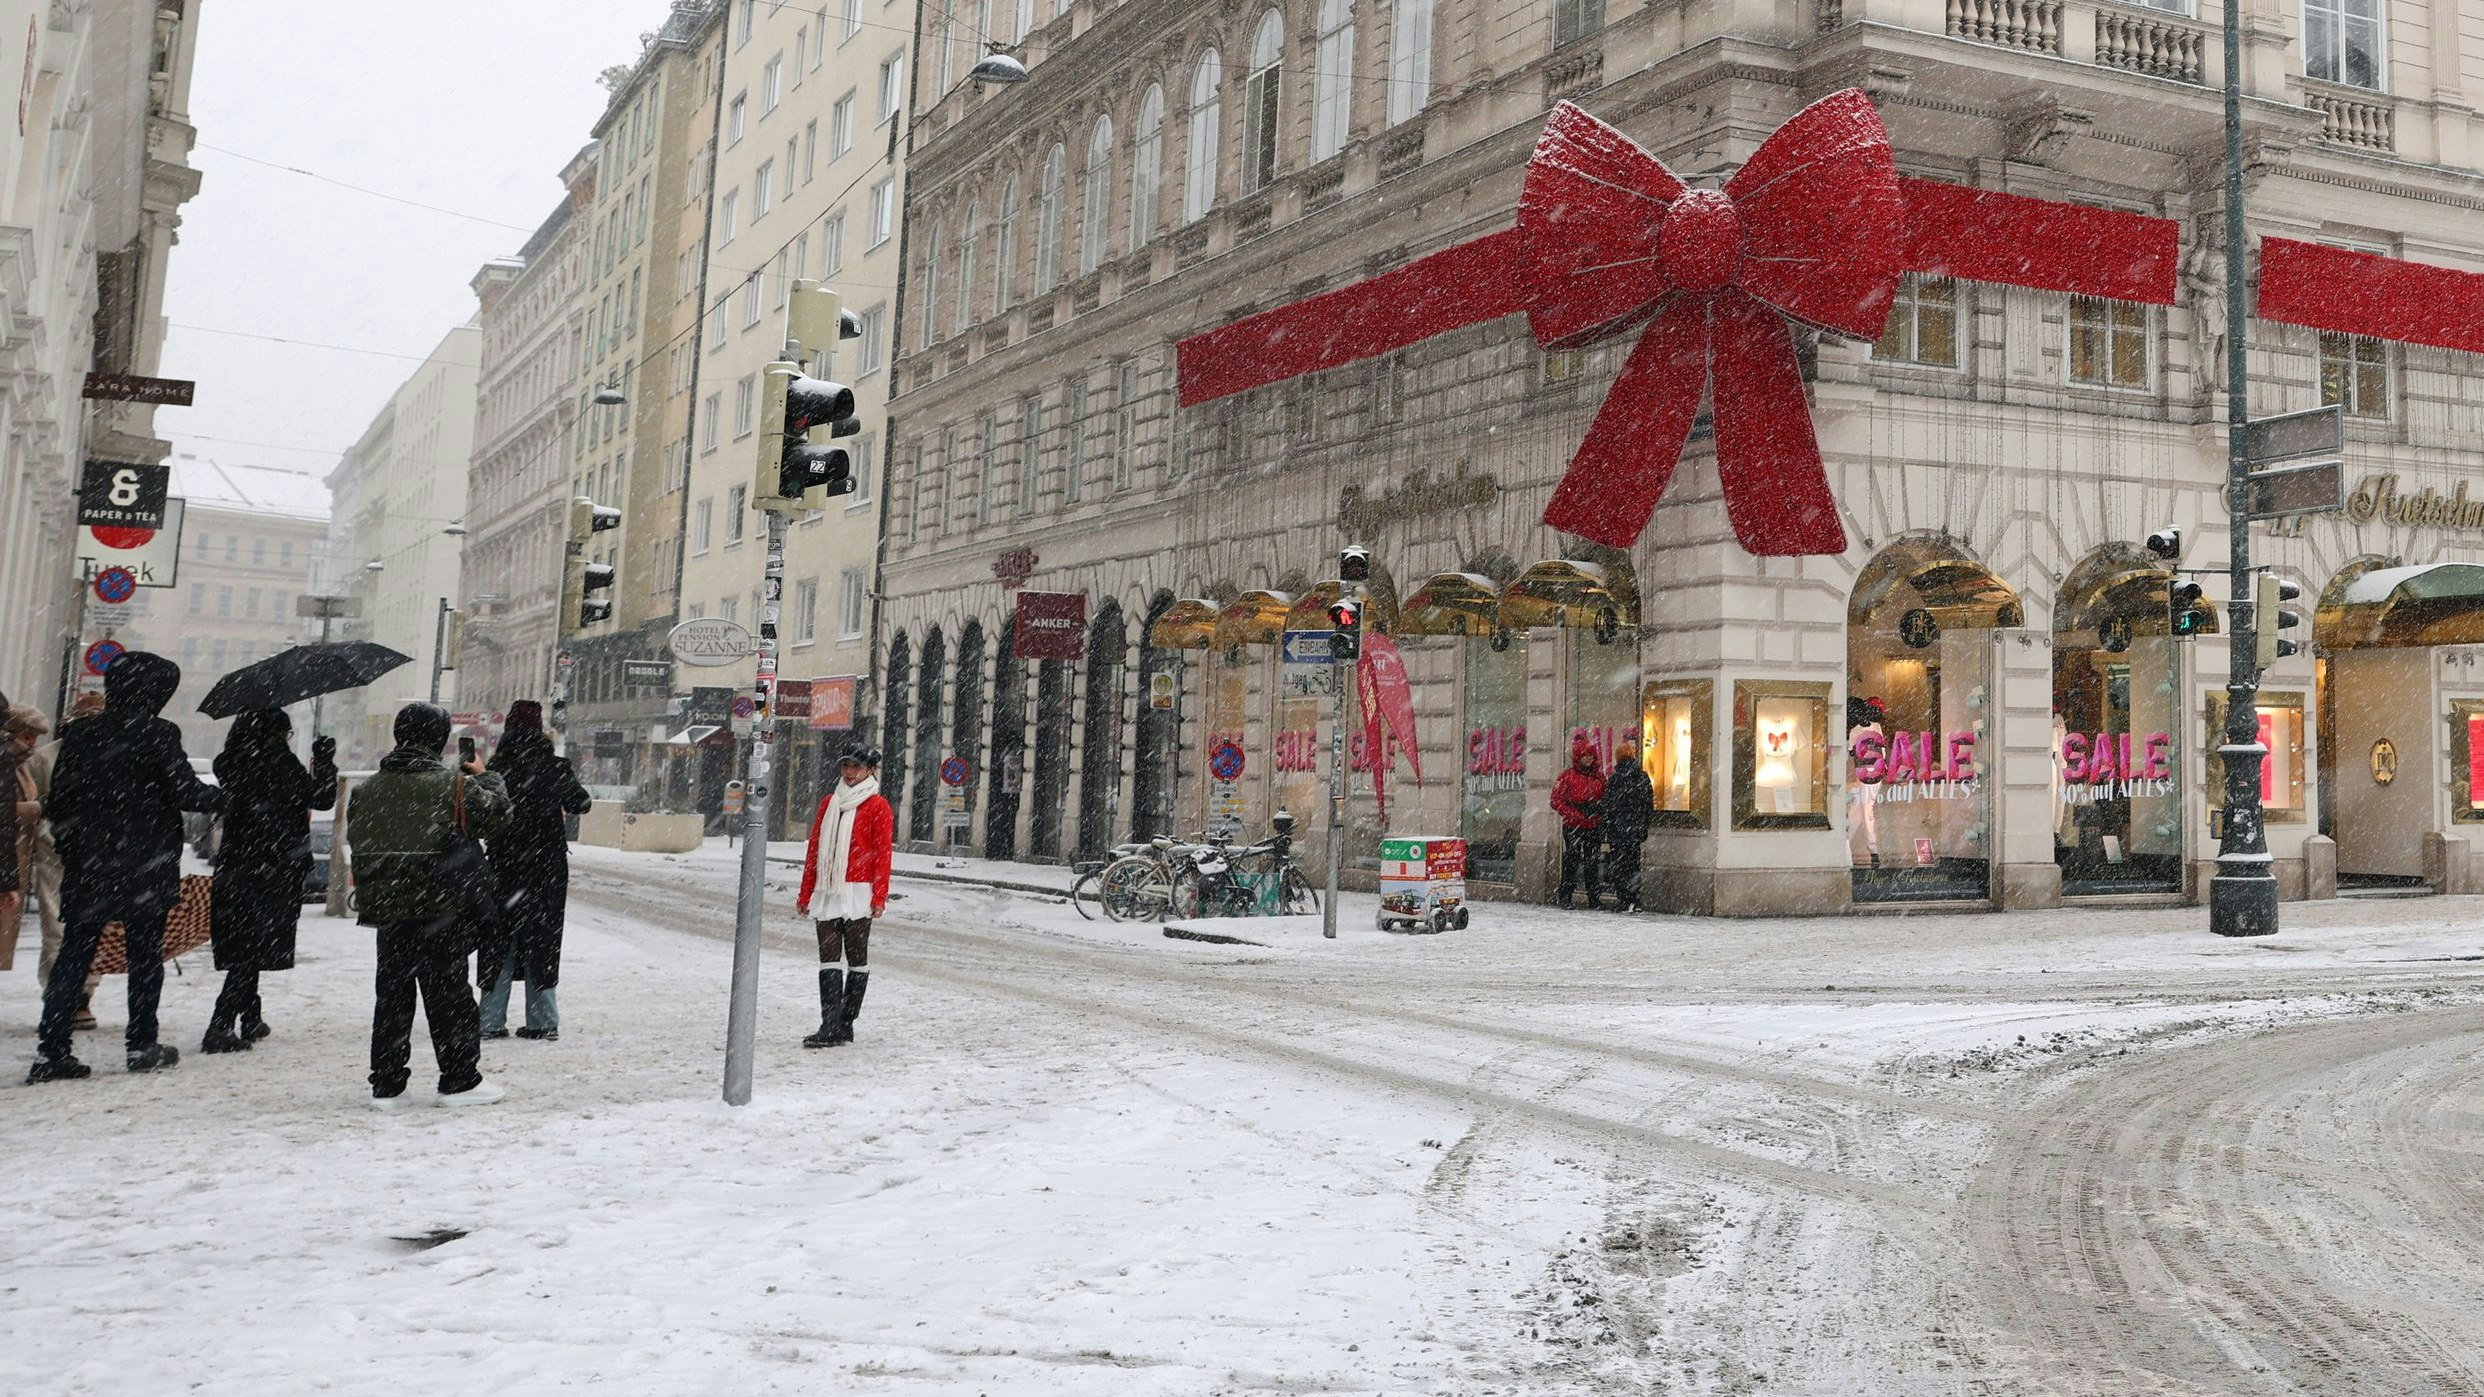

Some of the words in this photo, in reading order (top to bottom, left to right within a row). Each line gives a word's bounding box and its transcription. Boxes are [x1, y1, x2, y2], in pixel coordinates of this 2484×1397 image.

[84, 381, 131, 392] ZARA
[140, 387, 190, 397] HOME
[811, 462, 826, 473] 22
[84, 509, 122, 519] PAPER
[136, 512, 157, 521] TEA
[78, 556, 155, 582] Tuek
[689, 626, 720, 634] HOTEL
[1031, 618, 1071, 629] ANKER
[674, 641, 747, 653] SUZANNE
[1275, 730, 1317, 773] SALE
[1351, 730, 1396, 773] SAE
[1467, 727, 1527, 775] SALE
[1855, 731, 1975, 785] SALE
[2061, 732, 2170, 784] SALE
[1886, 779, 1914, 803] auf
[2090, 779, 2114, 801] auf
